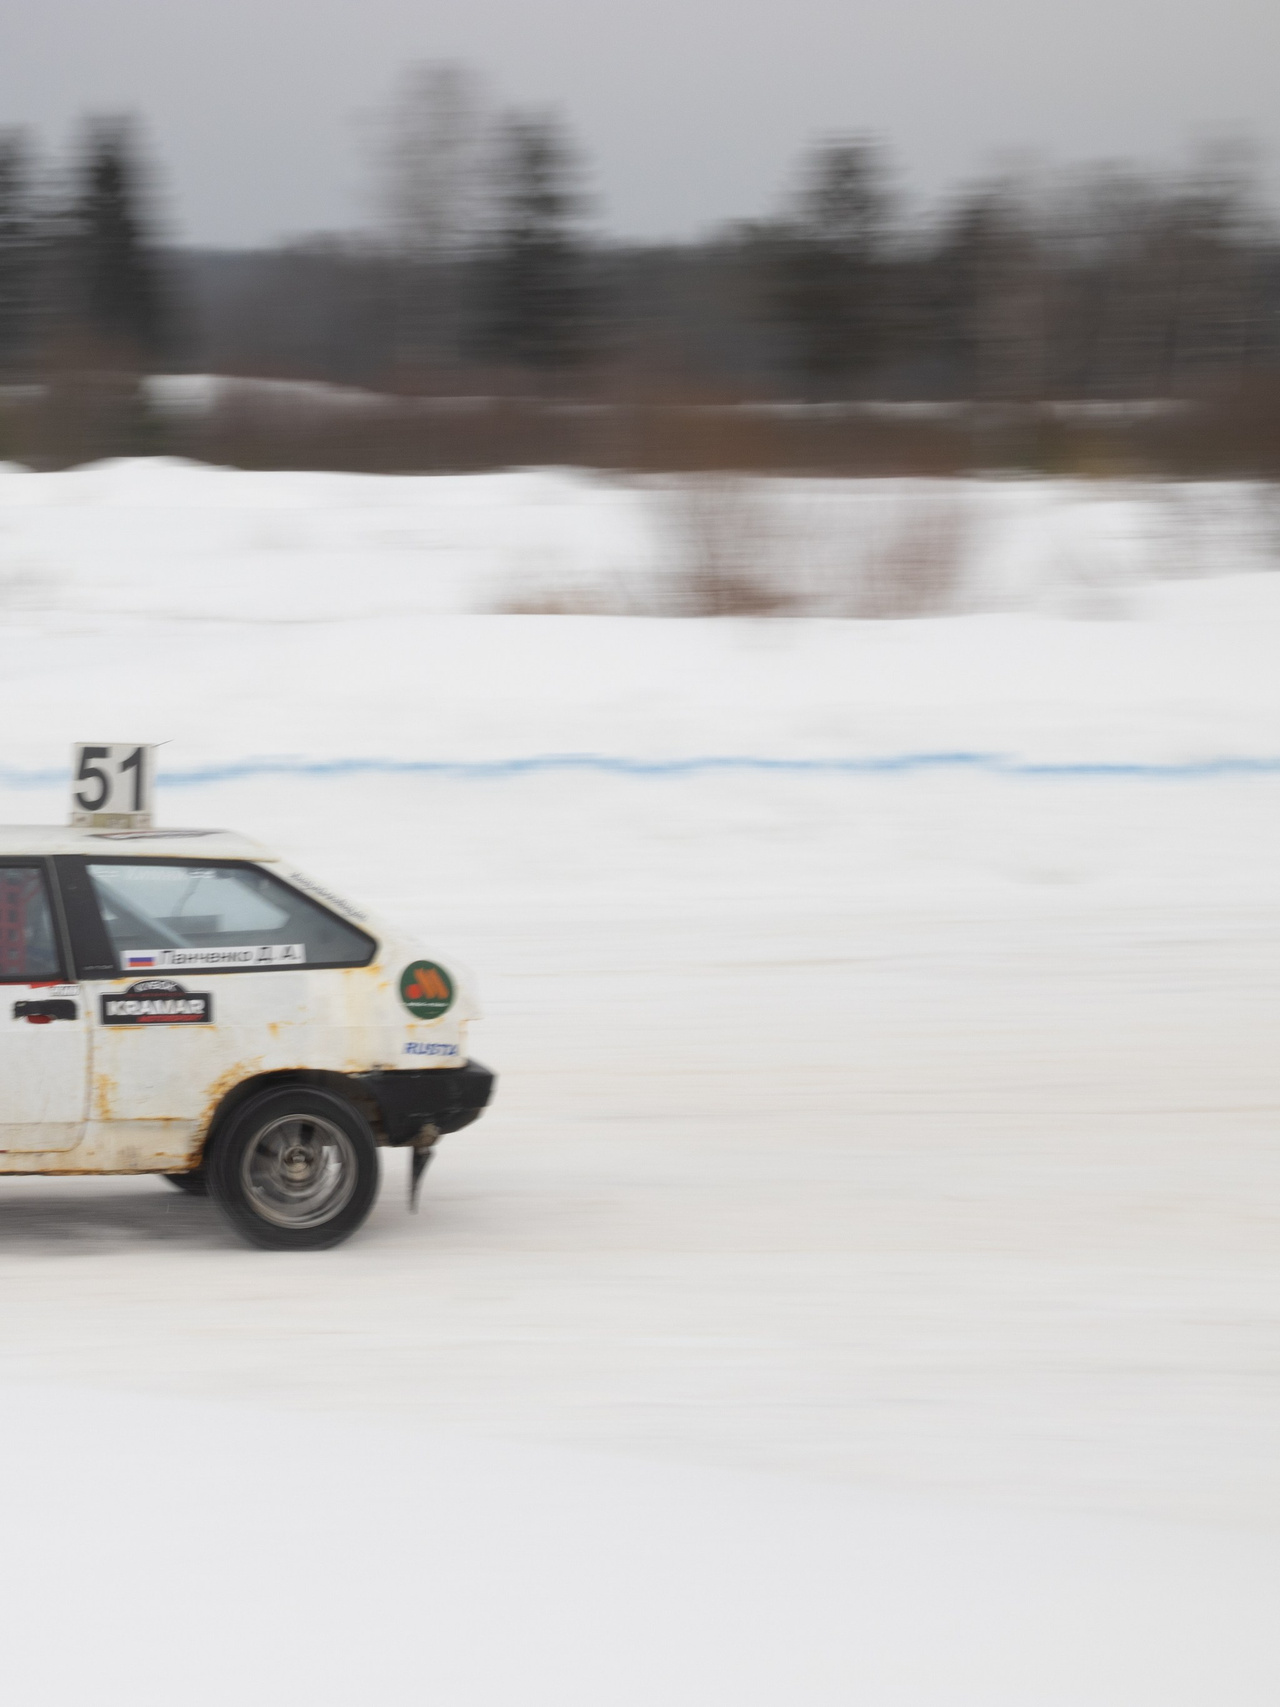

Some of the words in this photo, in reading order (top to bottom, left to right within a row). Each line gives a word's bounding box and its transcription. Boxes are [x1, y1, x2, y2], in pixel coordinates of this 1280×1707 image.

[75, 746, 143, 811] 51
[159, 950, 253, 966] Панченко
[105, 999, 206, 1016] KRAMAR
